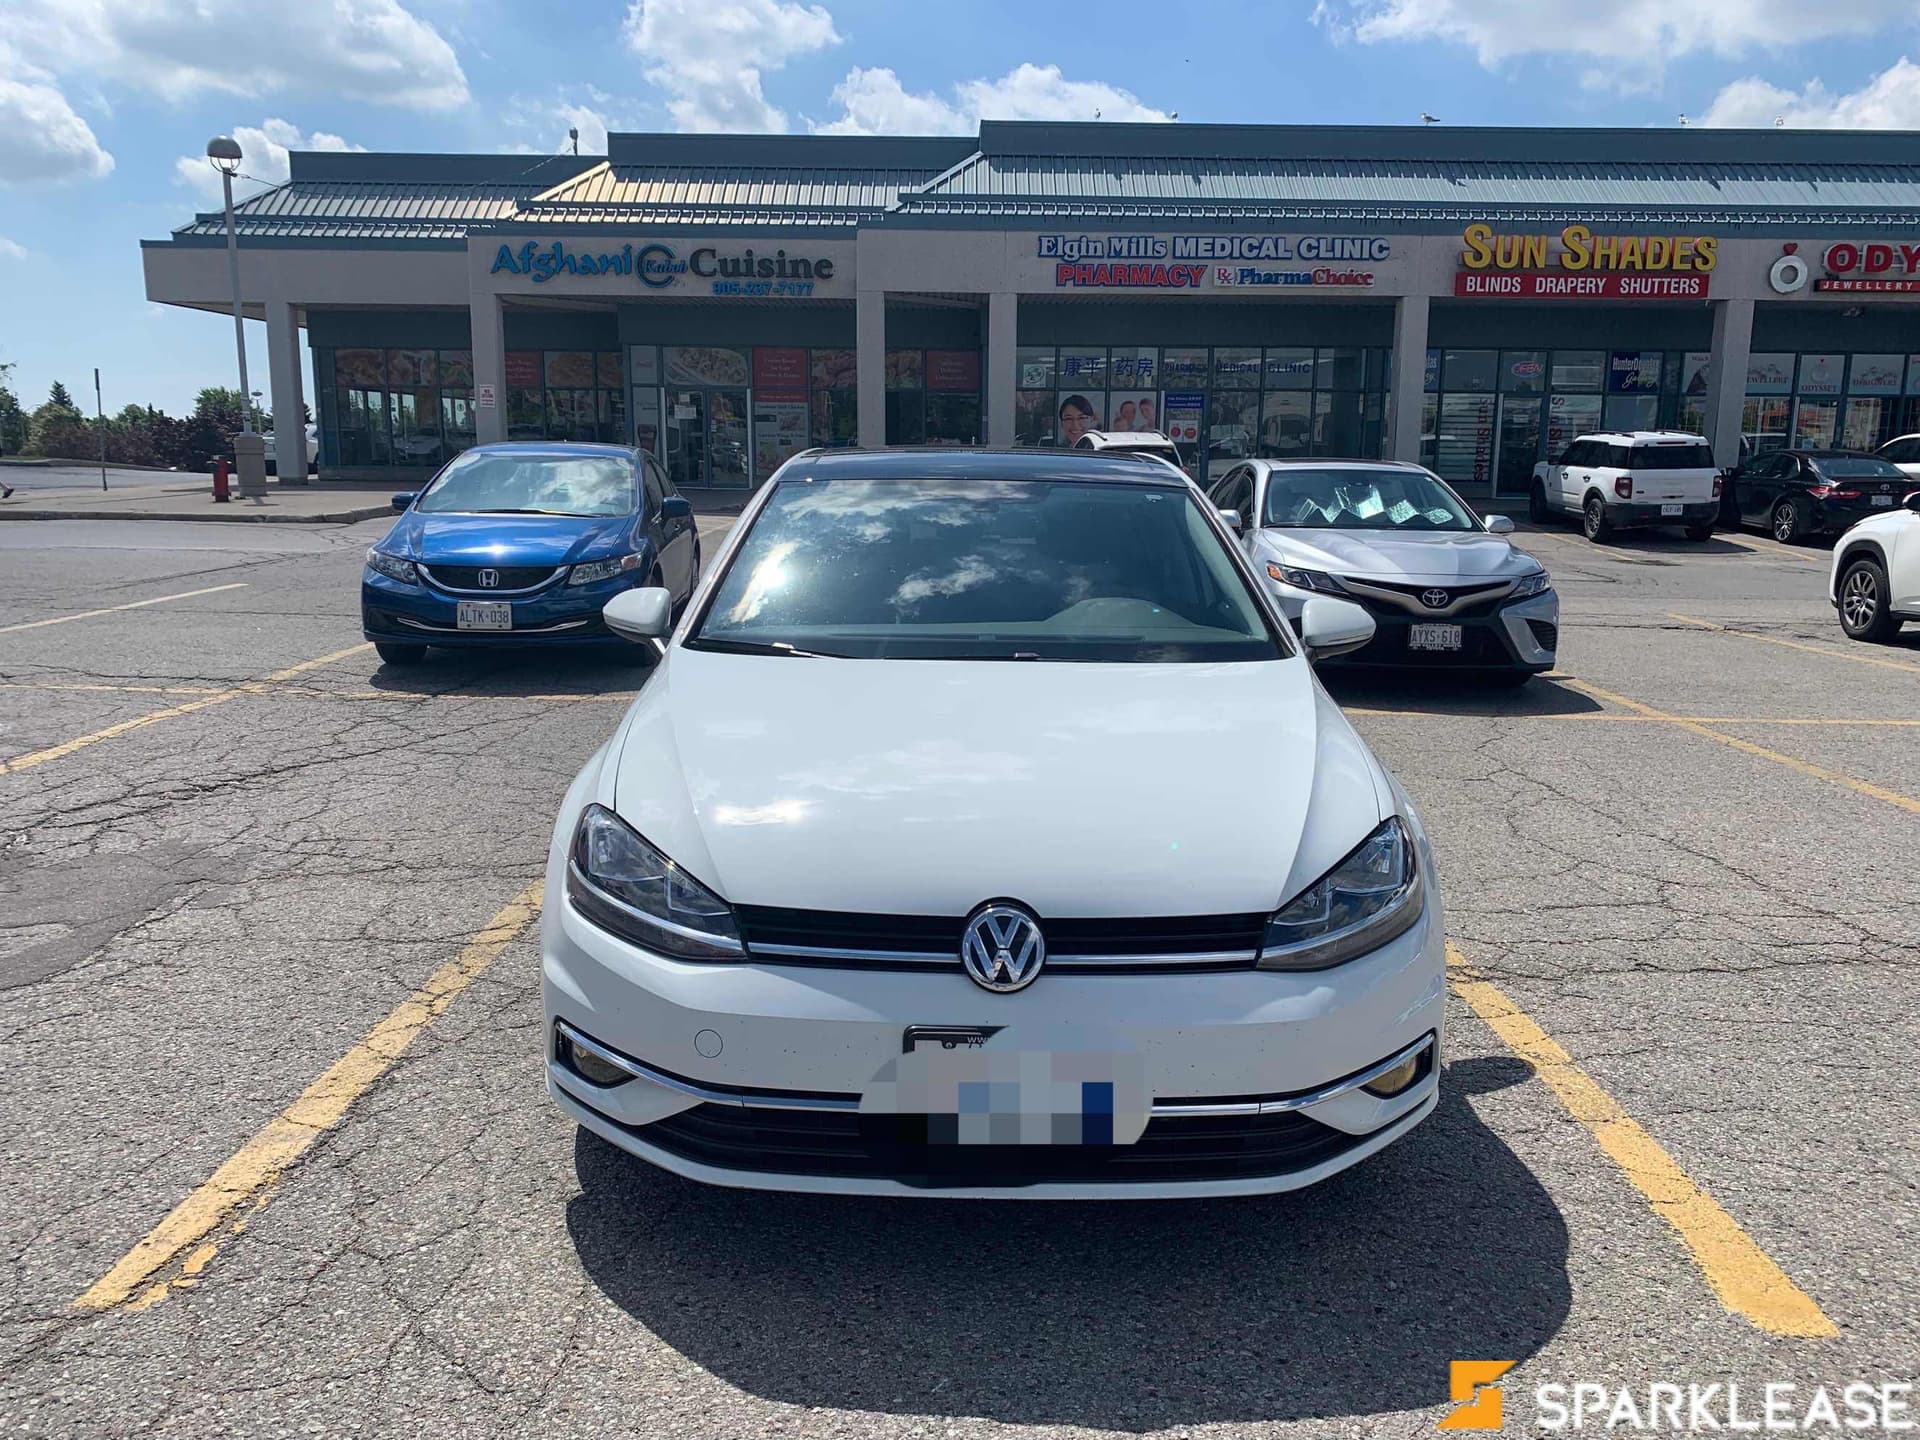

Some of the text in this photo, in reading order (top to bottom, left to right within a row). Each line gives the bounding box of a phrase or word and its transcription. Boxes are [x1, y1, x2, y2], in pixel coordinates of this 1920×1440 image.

[1038, 235, 1391, 263] Elgin Mills MEDICAL CLINIC
[1463, 223, 1718, 272] SUN SHADES
[490, 240, 632, 283] Afghani
[690, 248, 834, 279] Cuisine
[1056, 263, 1208, 287] PHARMACY
[1466, 275, 1700, 294] BLINDS DRAPERY SHUTTERS
[1823, 281, 1913, 290] JEWELLERY
[1216, 360, 1260, 374] MEDICAL
[1269, 362, 1311, 374] CLINIC
